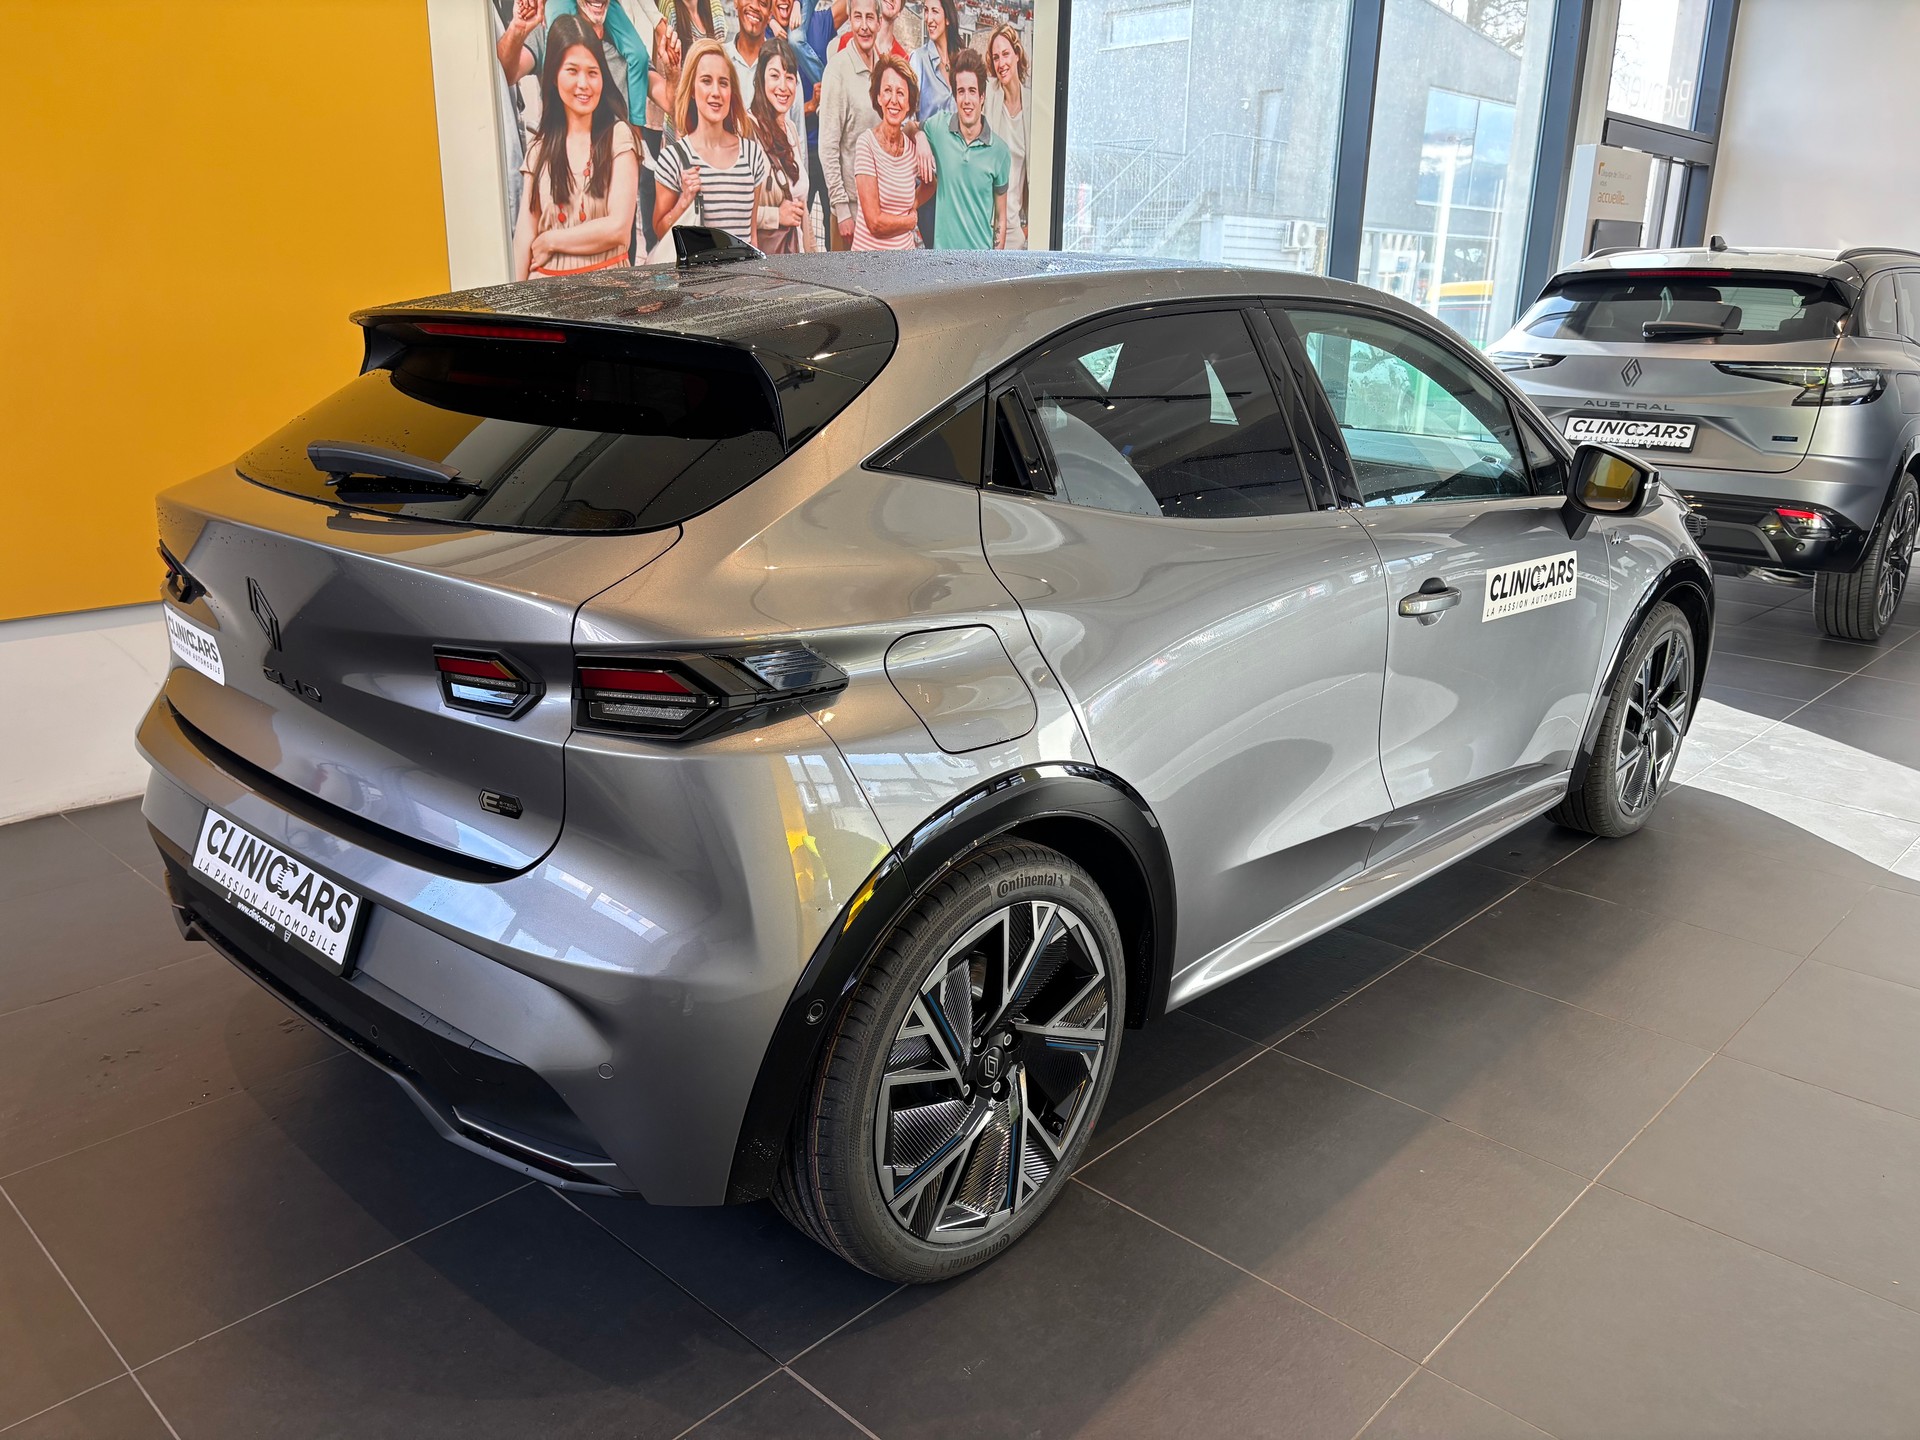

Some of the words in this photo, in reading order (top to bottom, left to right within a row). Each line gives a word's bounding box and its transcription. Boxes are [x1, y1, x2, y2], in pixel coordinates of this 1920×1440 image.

[1583, 399, 1675, 412] AUSTRAL
[1486, 605, 1496, 618] LA
[1498, 599, 1529, 614] PASSION
[1531, 587, 1573, 606] AUTOMOBILE
[262, 664, 323, 703] CLIO
[997, 872, 1057, 898] Continental
[198, 857, 210, 873] LA
[214, 868, 259, 905] PASSION
[261, 901, 337, 956] AUTOMOBILE
